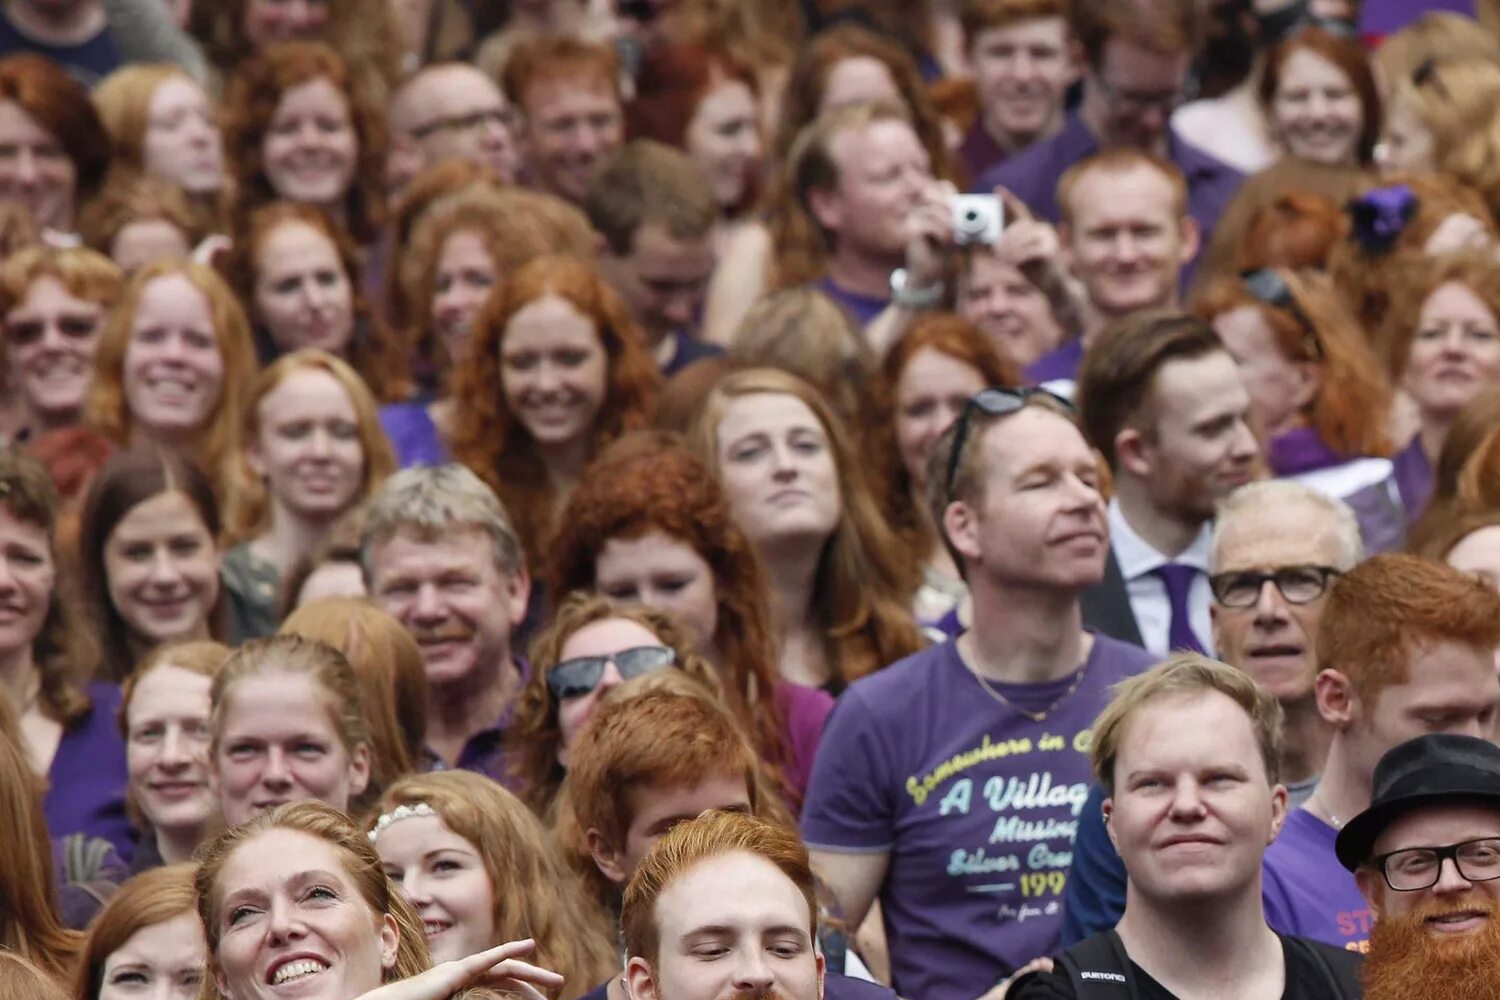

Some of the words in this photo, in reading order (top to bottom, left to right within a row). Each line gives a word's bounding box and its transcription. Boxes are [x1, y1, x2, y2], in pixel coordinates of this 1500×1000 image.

[906, 734, 1032, 806] Somewhere
[1038, 732, 1065, 752] in
[939, 778, 973, 816] A
[983, 771, 1089, 817] Villag
[1020, 871, 1066, 897] 199
